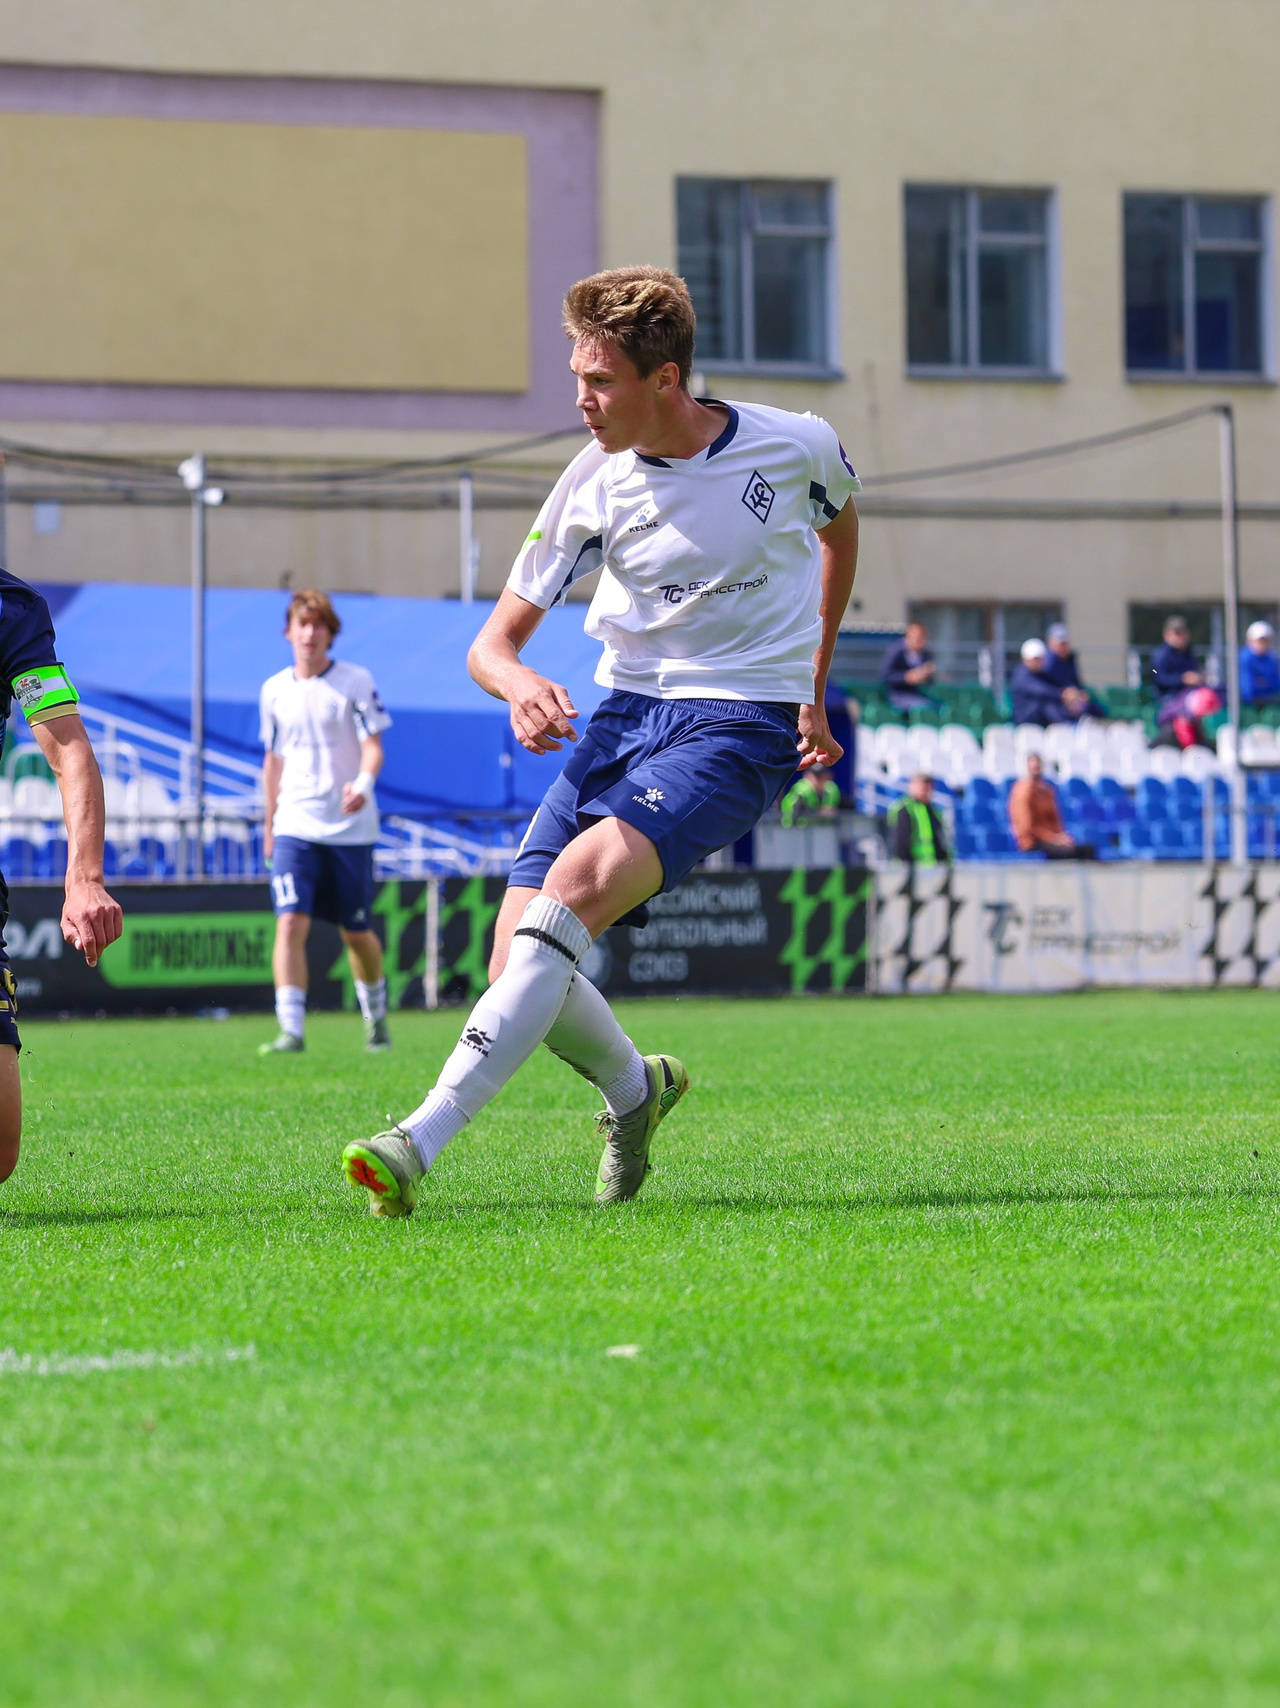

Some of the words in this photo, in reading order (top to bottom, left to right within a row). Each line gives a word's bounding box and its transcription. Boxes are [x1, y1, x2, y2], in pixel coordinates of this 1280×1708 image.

[629, 521, 660, 534] KELME
[688, 573, 768, 599] ТРАНССТРОЙ
[632, 795, 660, 813] KELME
[272, 871, 299, 907] 11
[648, 878, 762, 915] ССИЙСКИЙ
[130, 929, 267, 971] ПРИВОЛЖЬЕ
